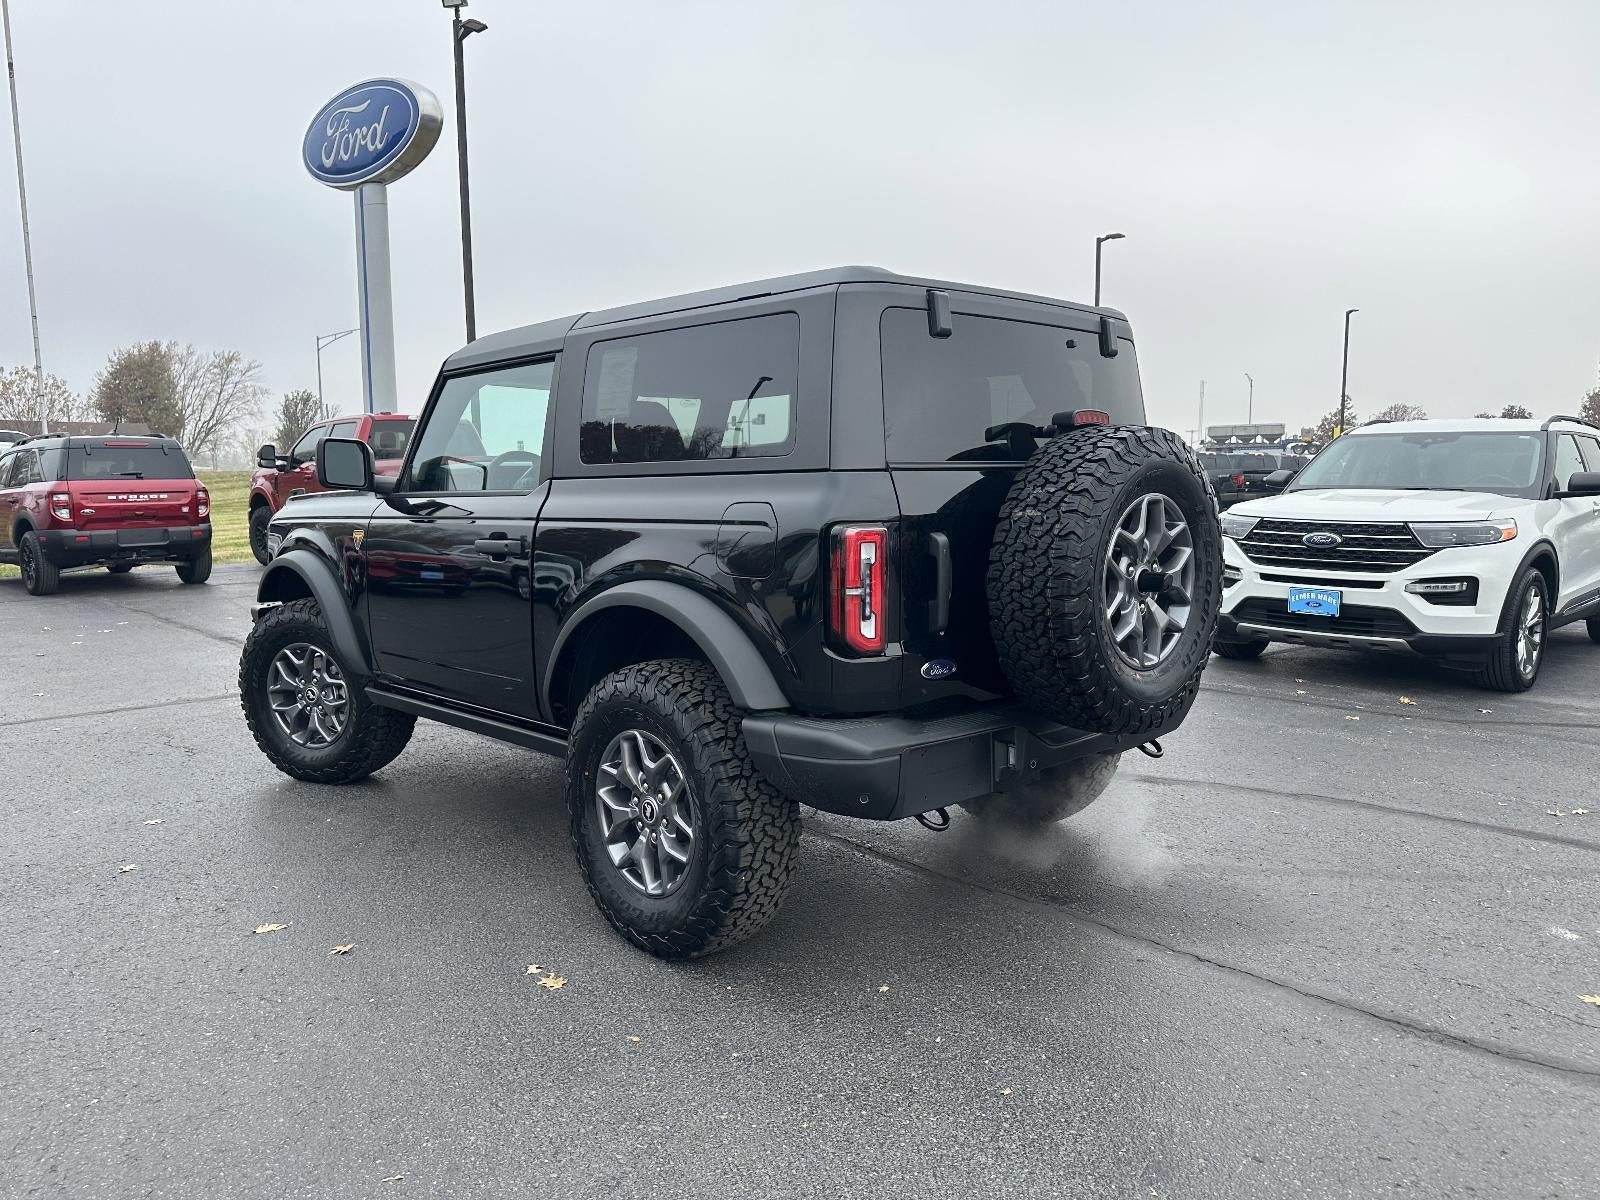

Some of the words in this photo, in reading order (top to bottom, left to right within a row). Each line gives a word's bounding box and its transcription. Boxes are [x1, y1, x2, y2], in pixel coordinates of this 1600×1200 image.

[321, 99, 389, 168] Ford
[1310, 535, 1332, 544] Ford
[1291, 593, 1316, 602] ELMER
[930, 663, 949, 676] Ford
